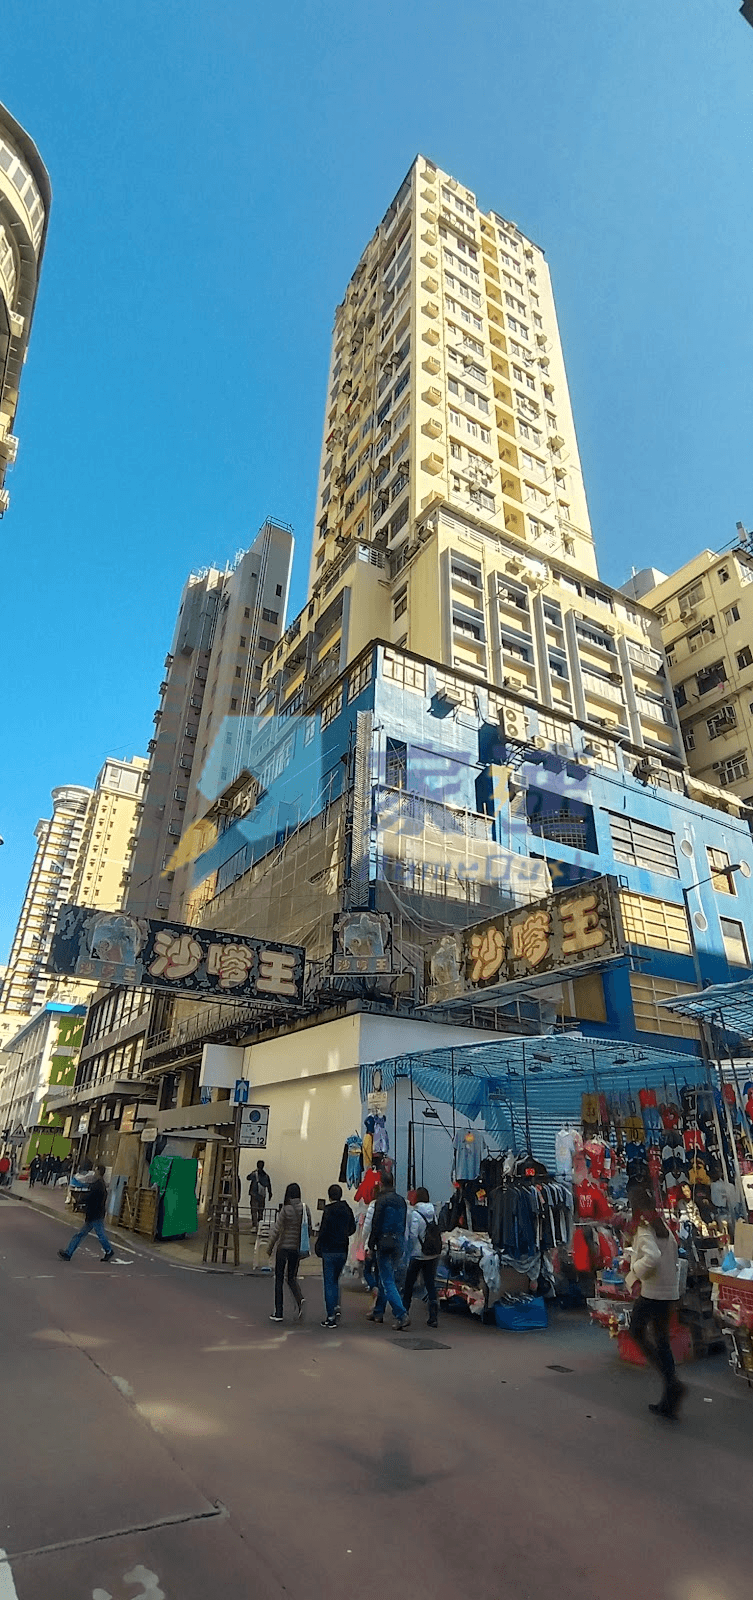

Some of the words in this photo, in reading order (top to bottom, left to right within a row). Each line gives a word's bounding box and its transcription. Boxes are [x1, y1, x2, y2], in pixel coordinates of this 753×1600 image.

[149, 931, 298, 997] 沙嗲王
[470, 894, 606, 982] 沙嗲王
